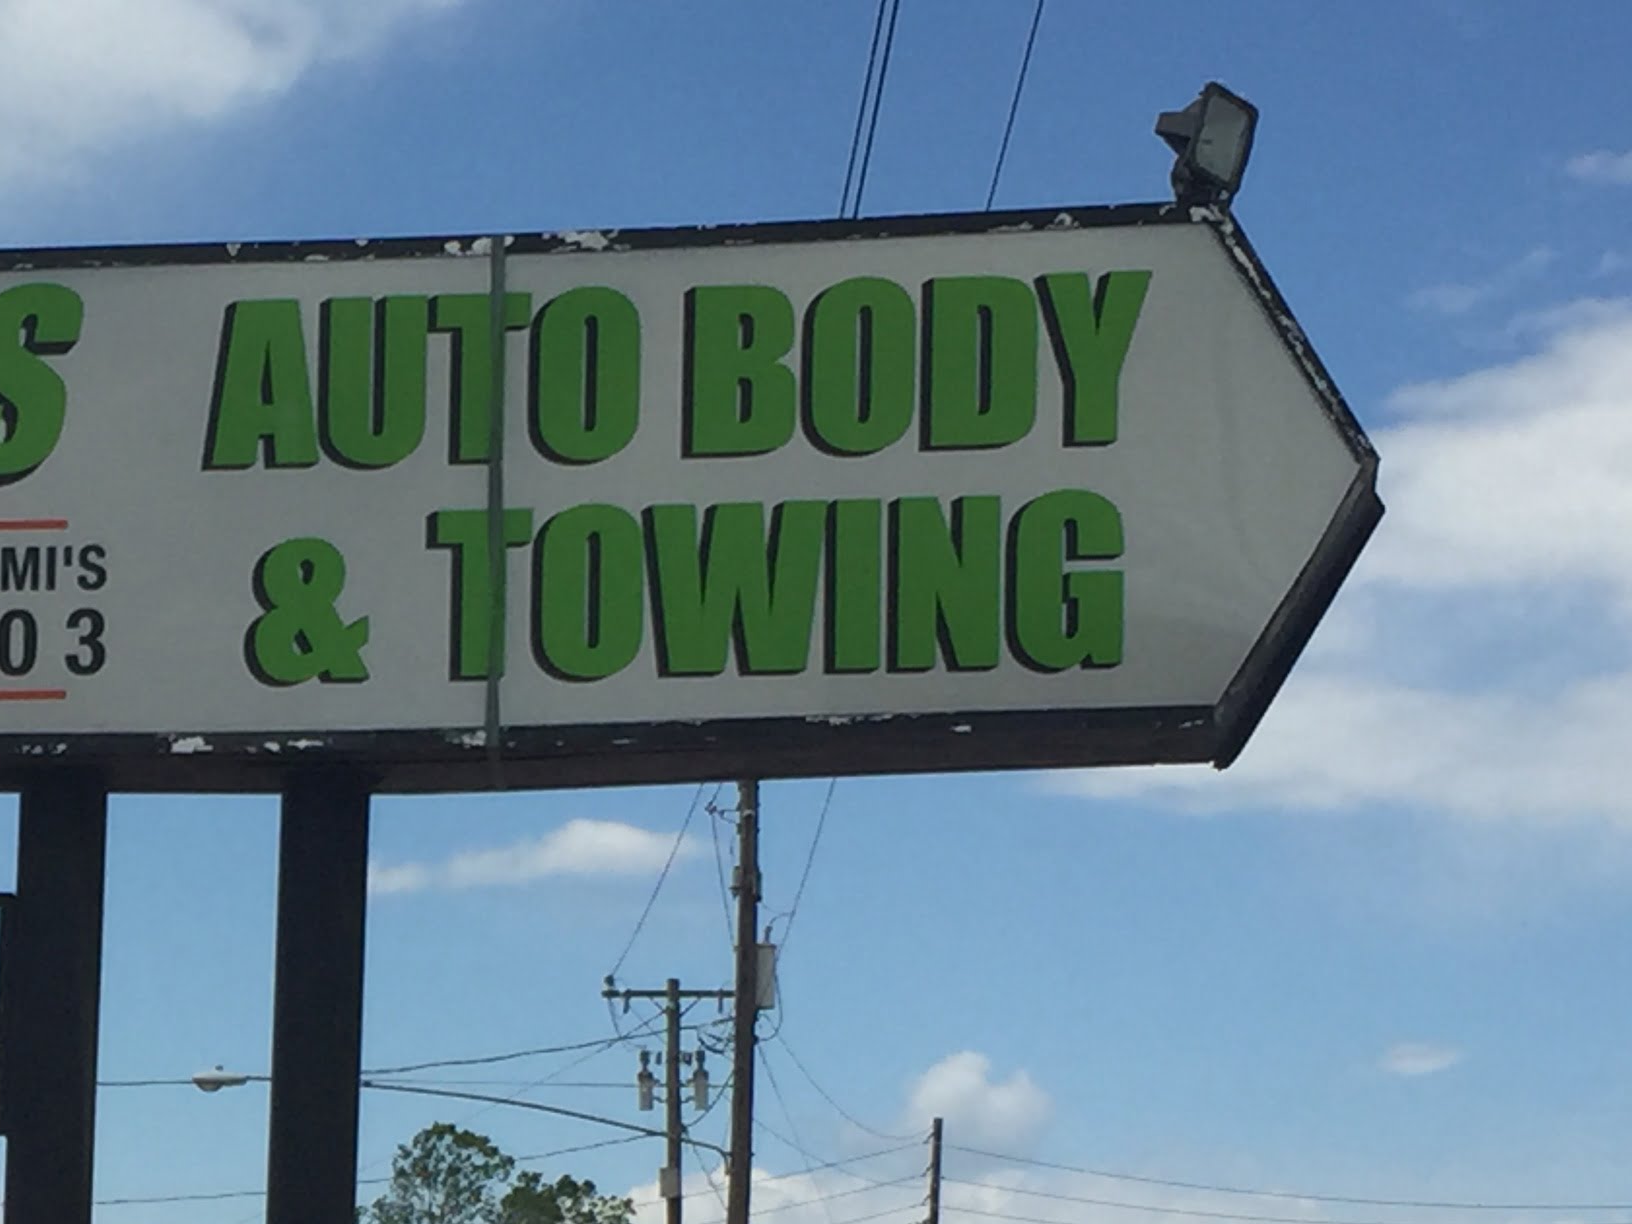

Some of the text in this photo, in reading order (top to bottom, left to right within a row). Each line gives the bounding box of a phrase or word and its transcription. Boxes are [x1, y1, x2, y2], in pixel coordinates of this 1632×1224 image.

[201, 270, 1153, 472] AUTO BODY
[244, 488, 1125, 687] & TOWING
